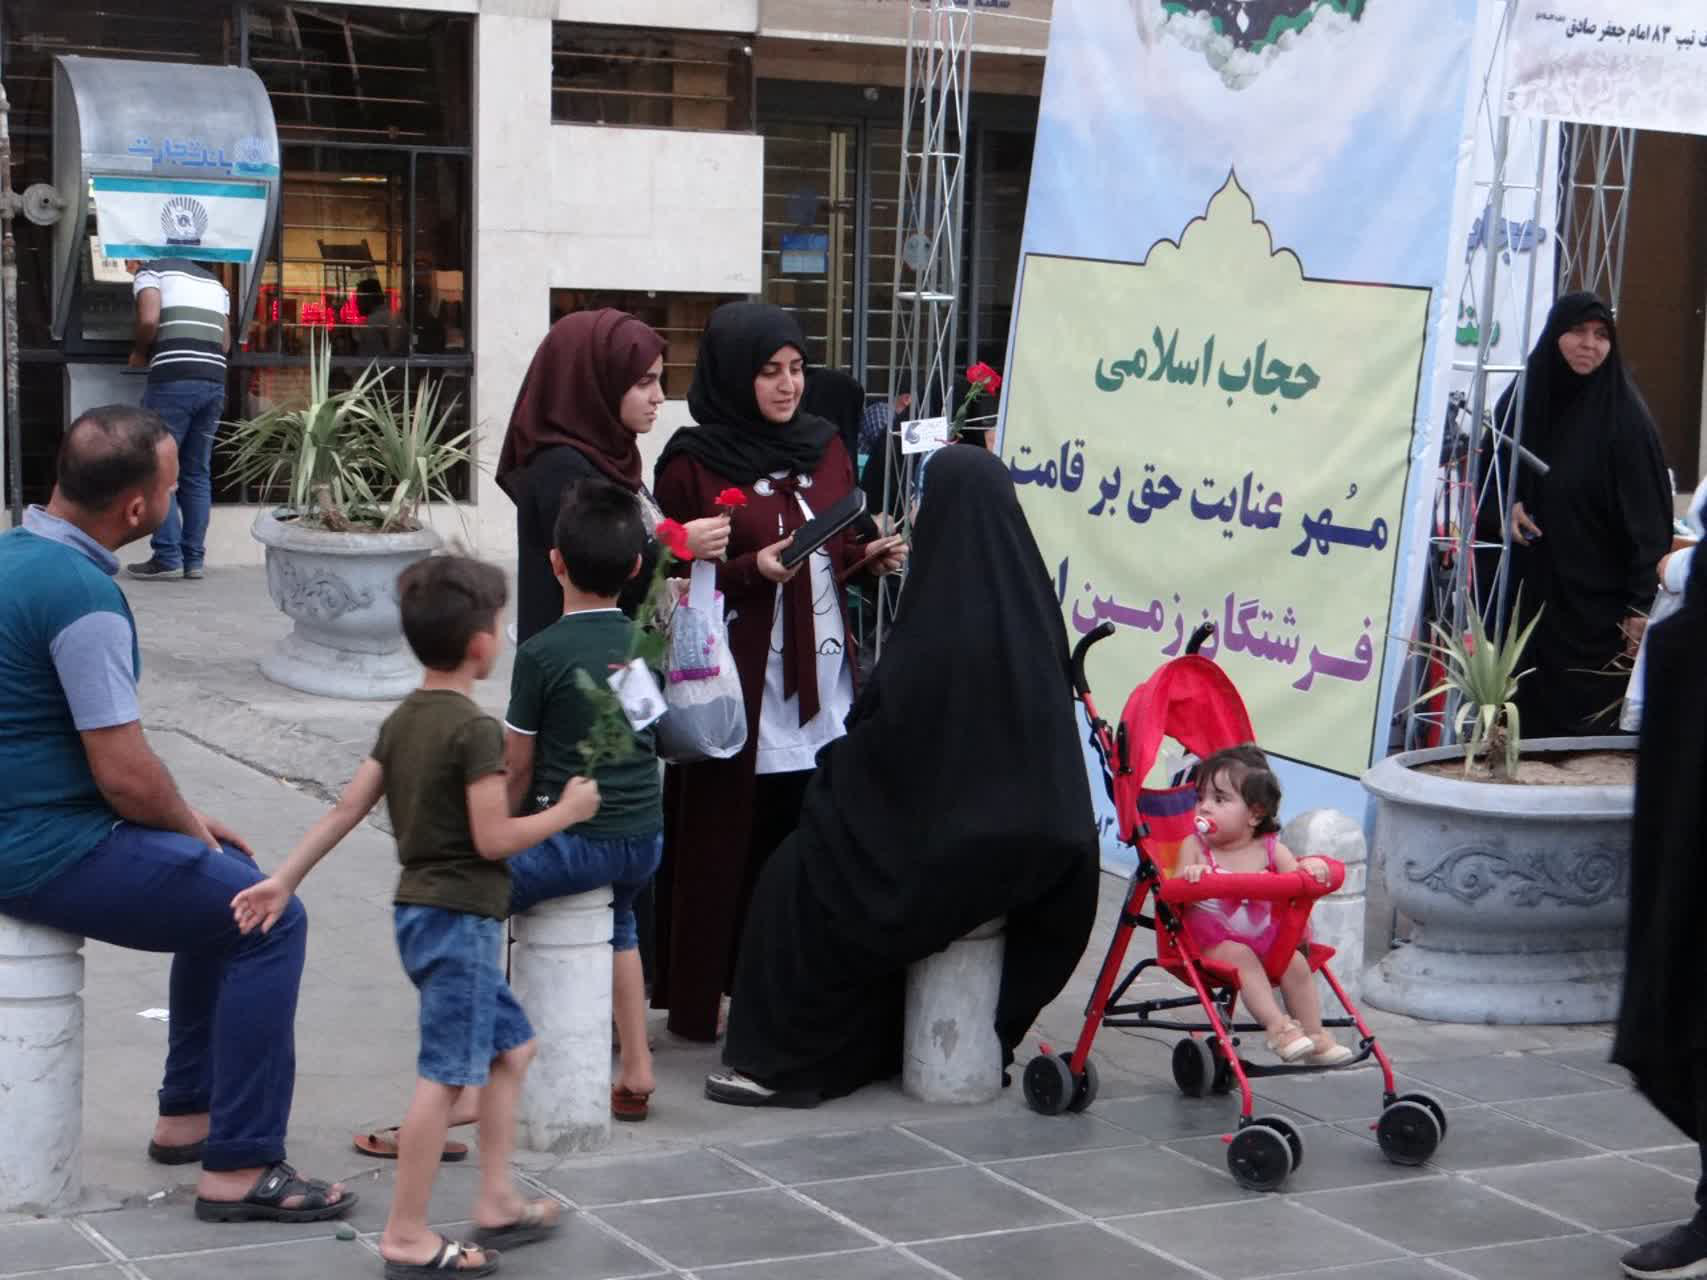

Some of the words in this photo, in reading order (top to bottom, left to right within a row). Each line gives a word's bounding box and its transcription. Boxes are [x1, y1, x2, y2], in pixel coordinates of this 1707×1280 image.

[1566, 17, 1597, 38] صادق
[1597, 20, 1626, 43] جعفر
[1628, 23, 1650, 44] امام
[1095, 325, 1216, 392] اسلامی
[1218, 339, 1321, 414] حجاب
[1009, 439, 1085, 493] قامت
[1088, 466, 1121, 516] بر
[1127, 463, 1182, 524] حق
[1190, 471, 1283, 539] عنایت
[1072, 581, 1184, 657] زمین
